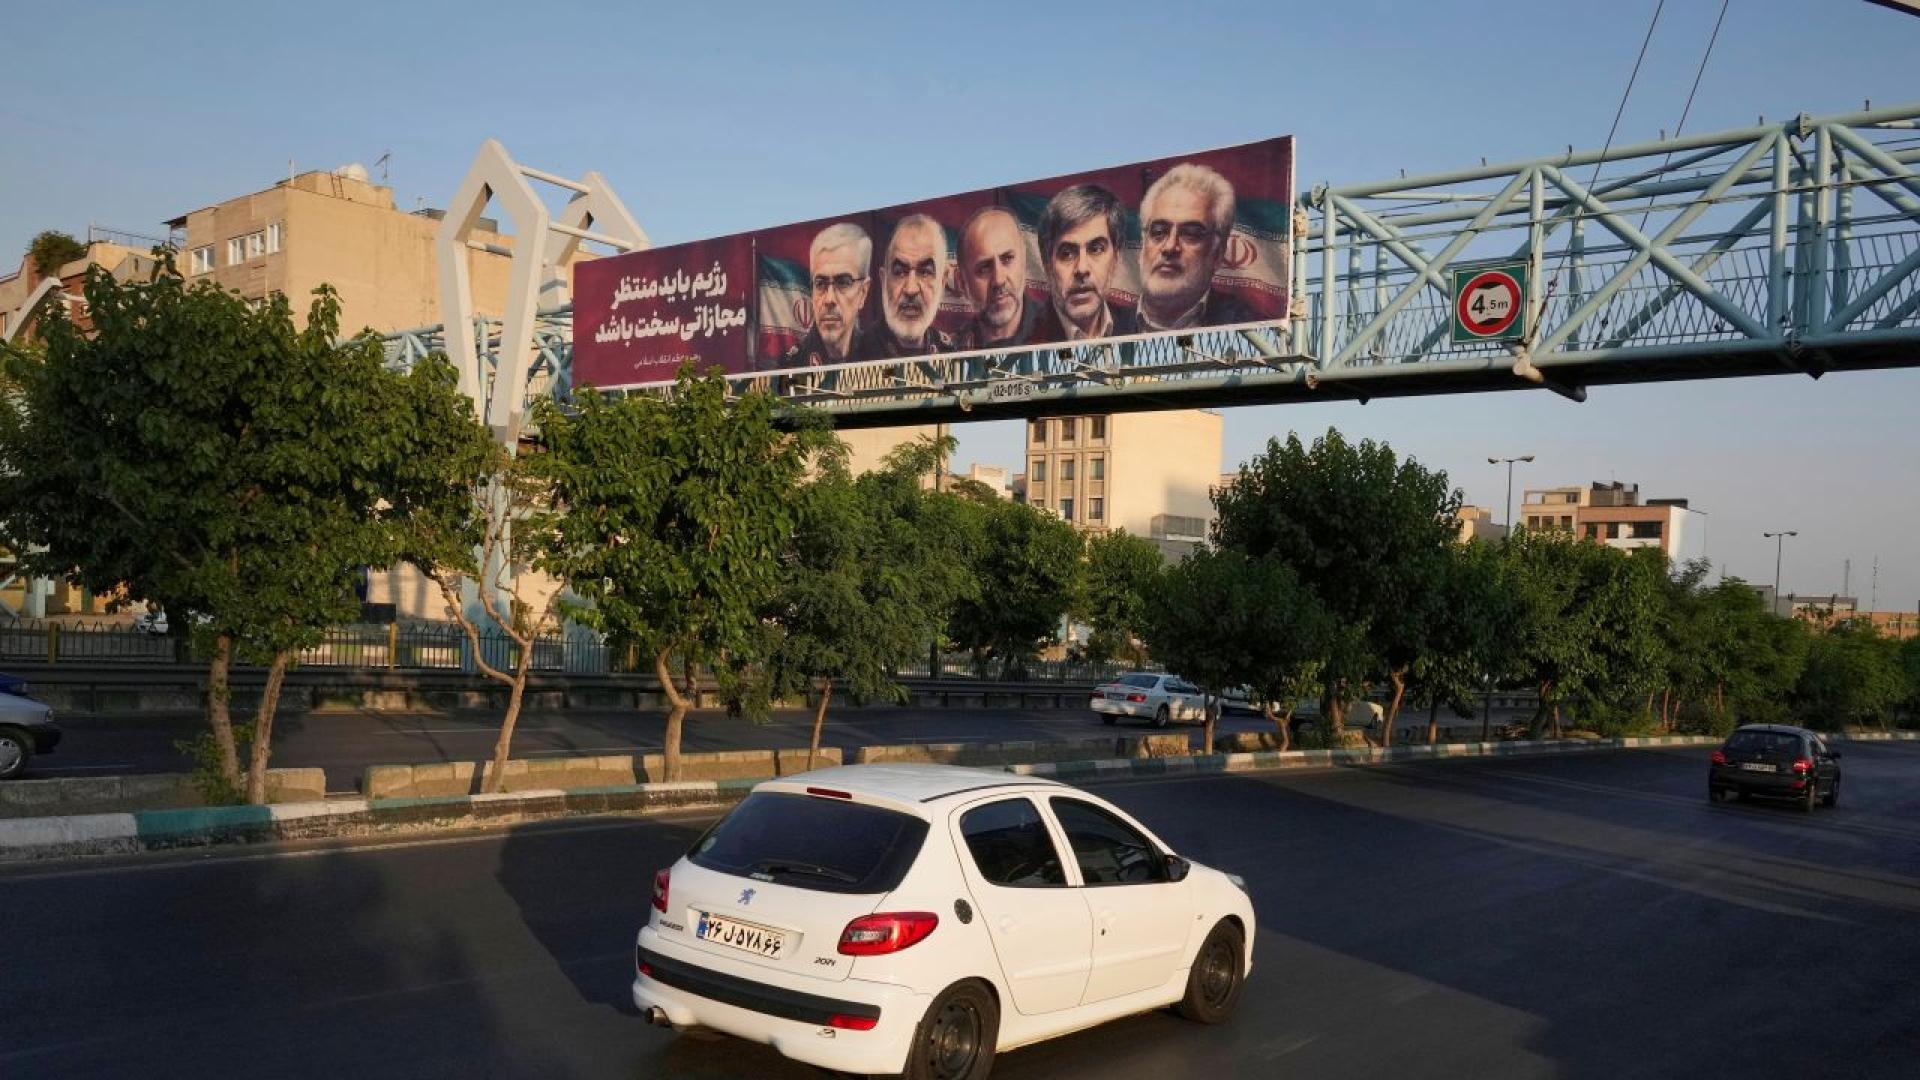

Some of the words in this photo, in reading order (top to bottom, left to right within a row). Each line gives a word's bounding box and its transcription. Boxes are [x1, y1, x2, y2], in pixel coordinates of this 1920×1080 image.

[610, 276, 658, 309] منتظر
[658, 268, 691, 303] باید
[692, 260, 726, 299] رژیم
[595, 315, 634, 348] باشد
[634, 309, 679, 338] سخت
[681, 303, 746, 341] مجازاتی
